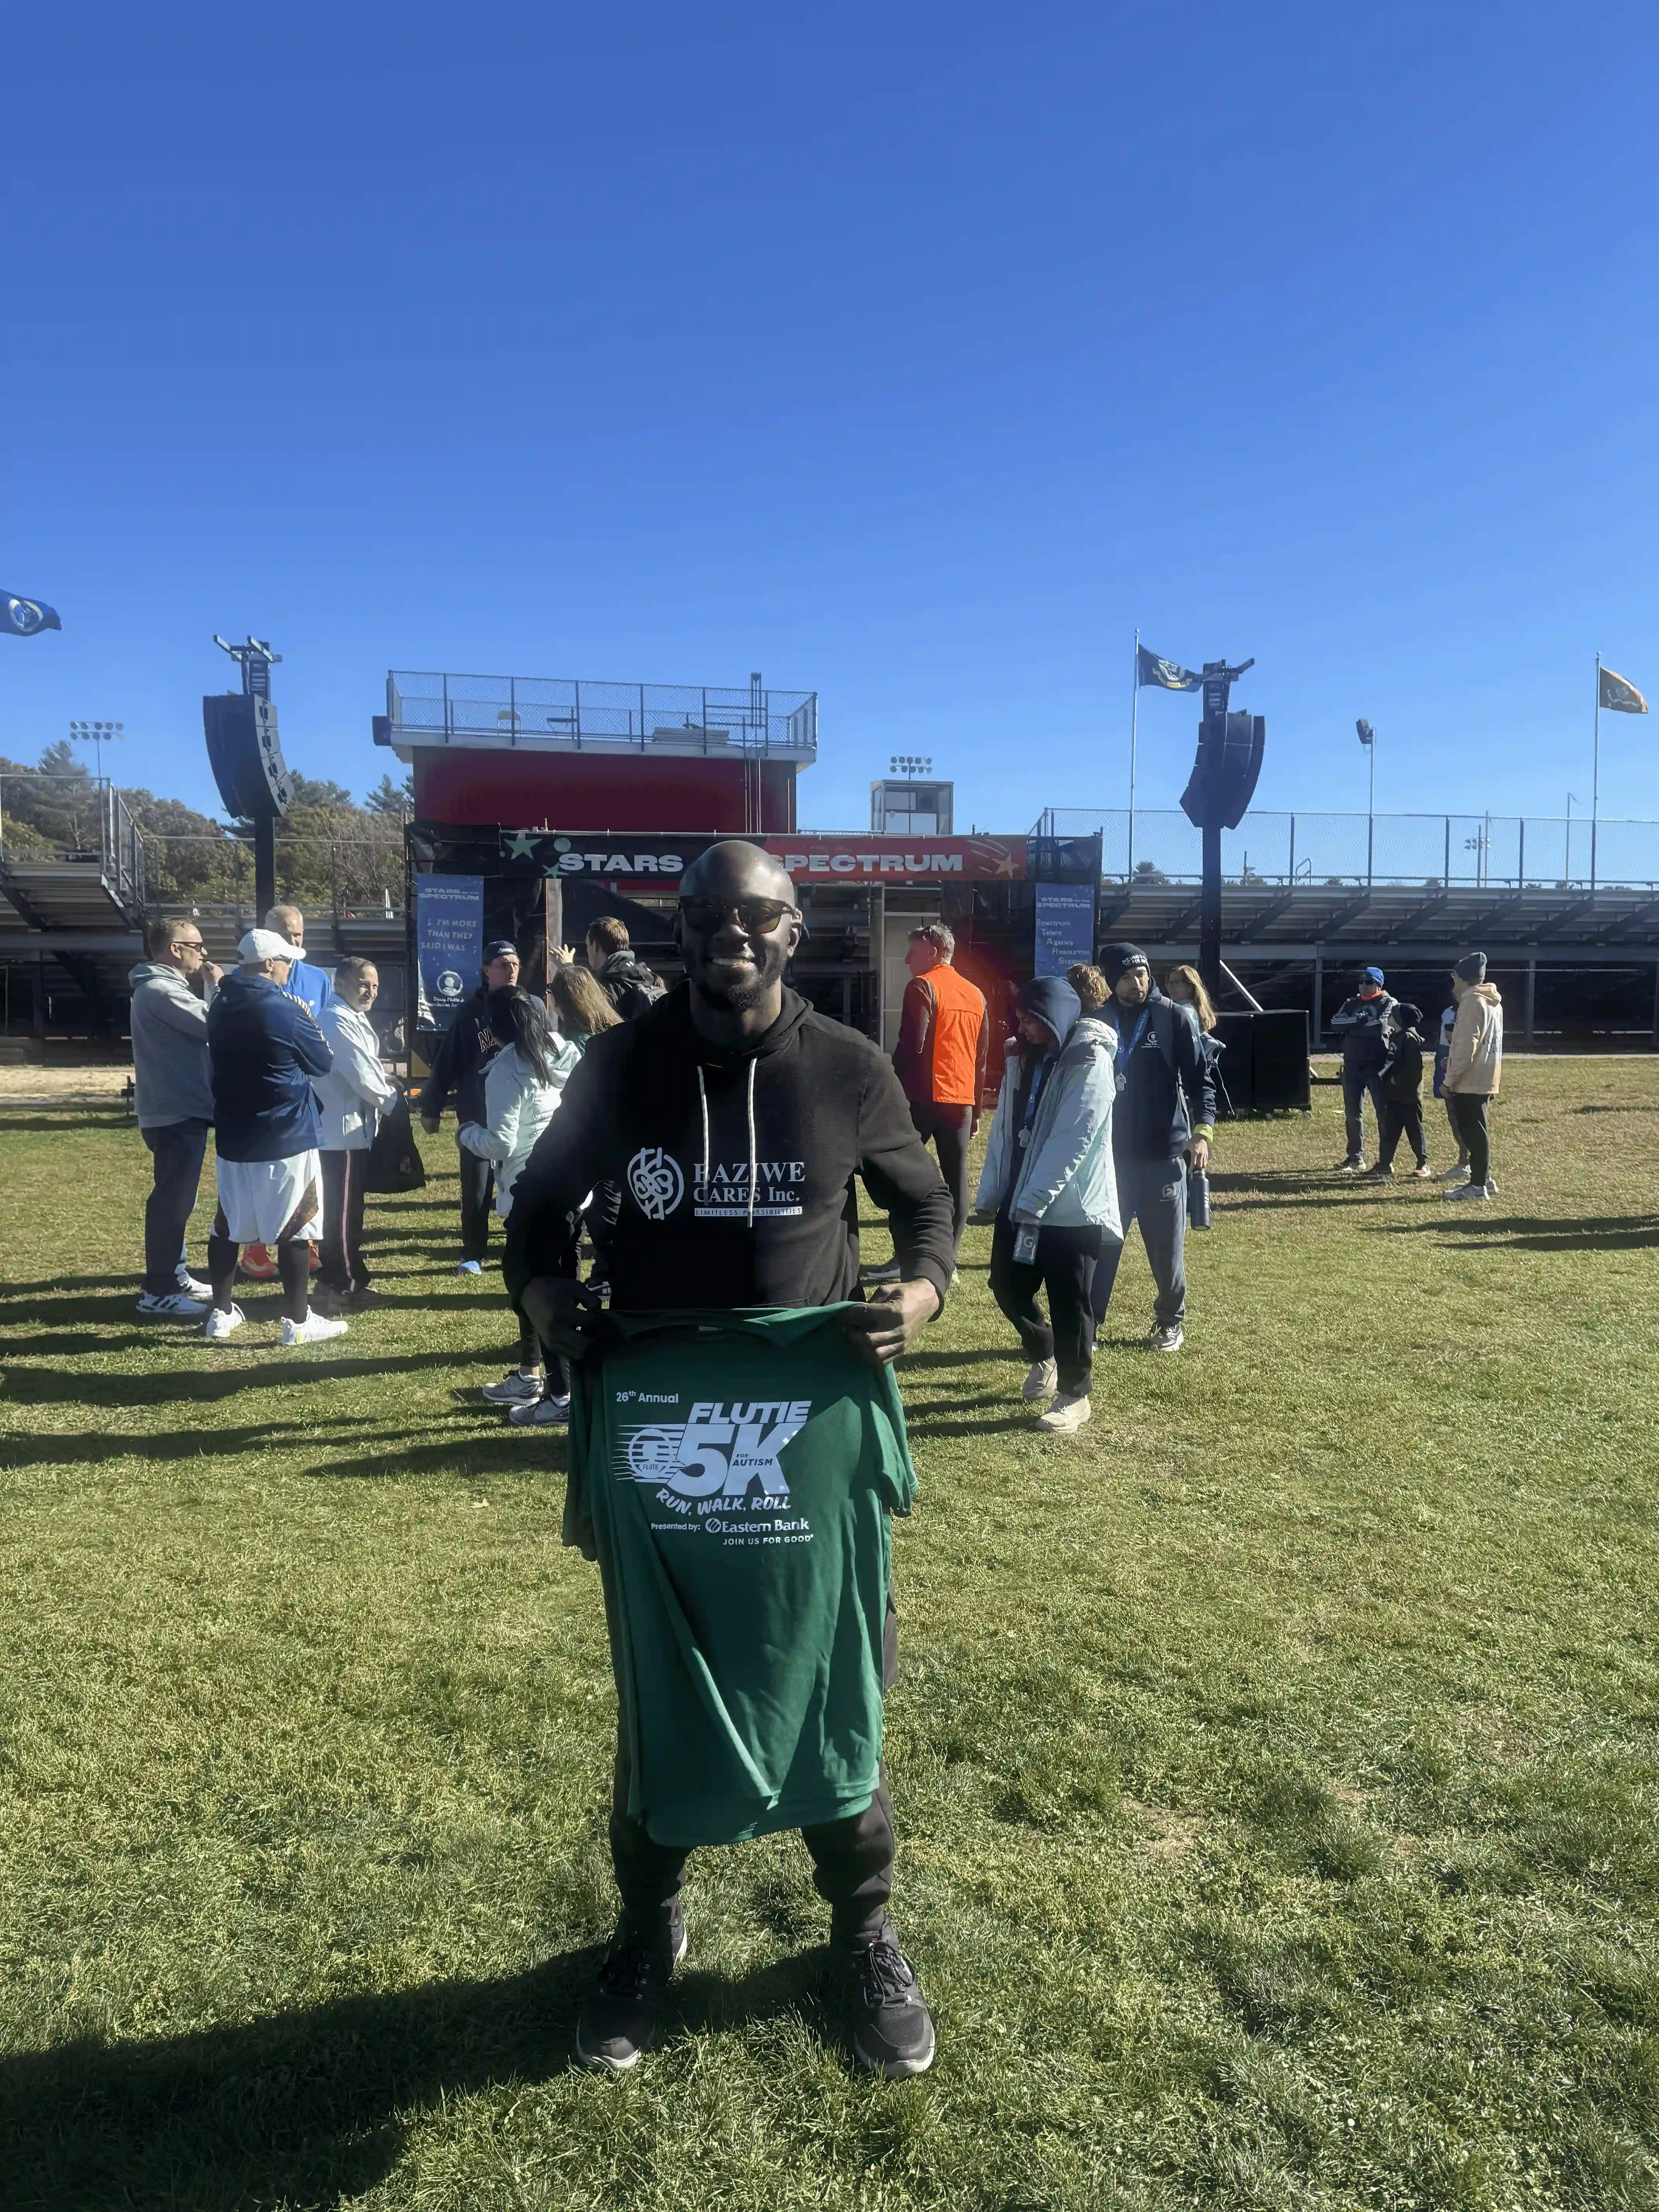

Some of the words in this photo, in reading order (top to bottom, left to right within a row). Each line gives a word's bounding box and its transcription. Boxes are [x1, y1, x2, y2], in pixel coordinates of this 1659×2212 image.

[559, 853, 683, 872] STARS
[1036, 919, 1071, 927] Spectrum
[427, 930, 450, 938] THAN
[452, 931, 473, 939] THEY
[1046, 938, 1074, 946] Agency
[768, 1187, 800, 1202] Inc.
[616, 1391, 636, 1402] 26th
[638, 1393, 678, 1403] Annual
[688, 1400, 812, 1424] FLUTIE
[666, 1422, 806, 1497] 5K
[732, 1458, 773, 1466] AUTISM
[656, 1488, 692, 1516] RUN,
[697, 1497, 746, 1515] WALK,
[751, 1496, 791, 1510] ROLL
[688, 1523, 700, 1532] by:
[722, 1521, 771, 1532] Eastern
[774, 1518, 809, 1531] Bank
